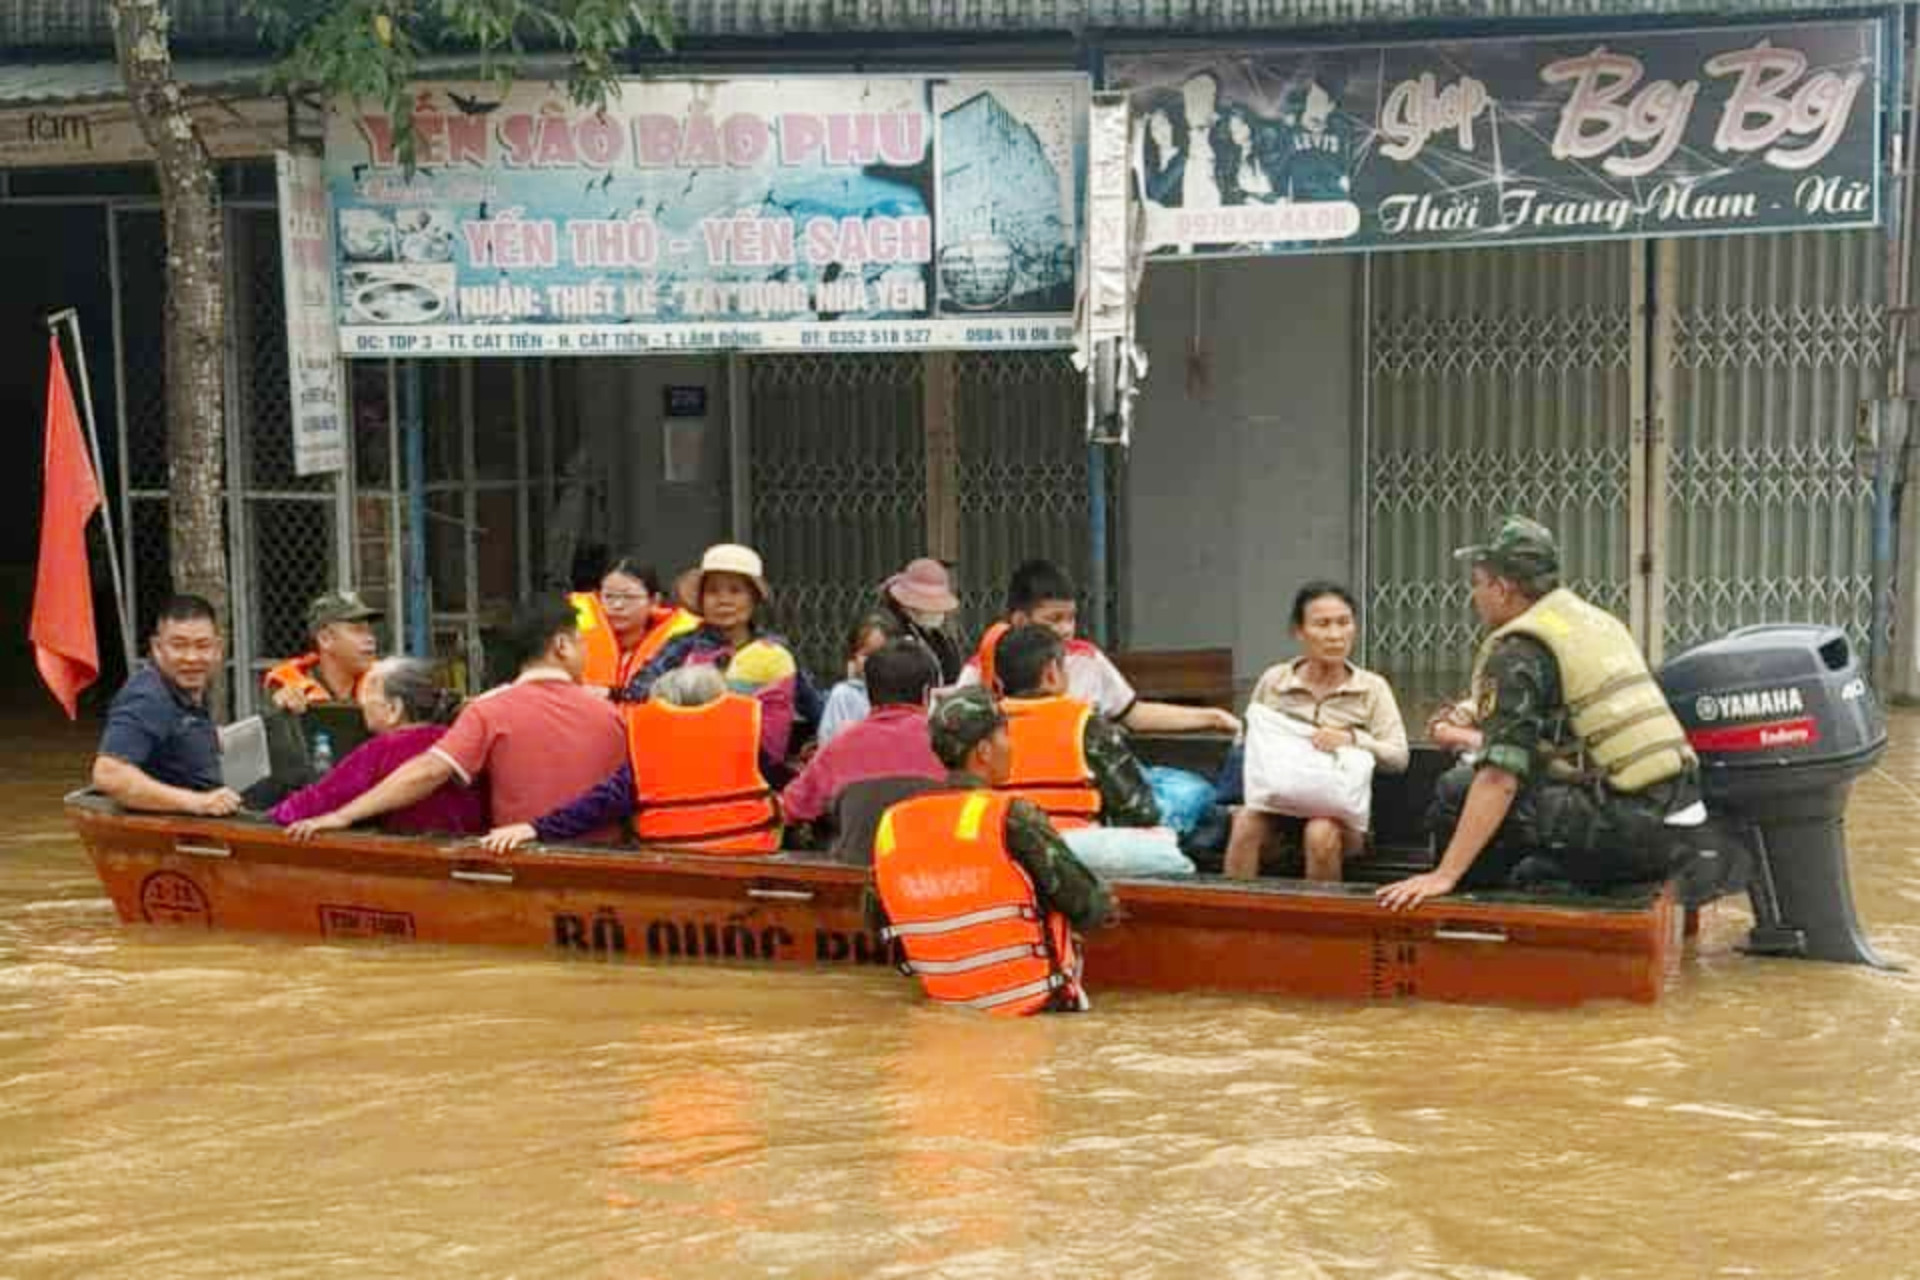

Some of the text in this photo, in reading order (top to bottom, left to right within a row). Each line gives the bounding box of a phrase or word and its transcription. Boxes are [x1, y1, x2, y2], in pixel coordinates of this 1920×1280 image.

[1379, 71, 1490, 160] Shop
[1378, 192, 1480, 234] Thời
[1484, 188, 1632, 233] Trang
[1643, 177, 1758, 222] Nam
[464, 208, 557, 267] YẾN
[568, 210, 658, 267] THÔ
[904, 328, 931, 342] 527
[1717, 687, 1804, 718] YAMAHA
